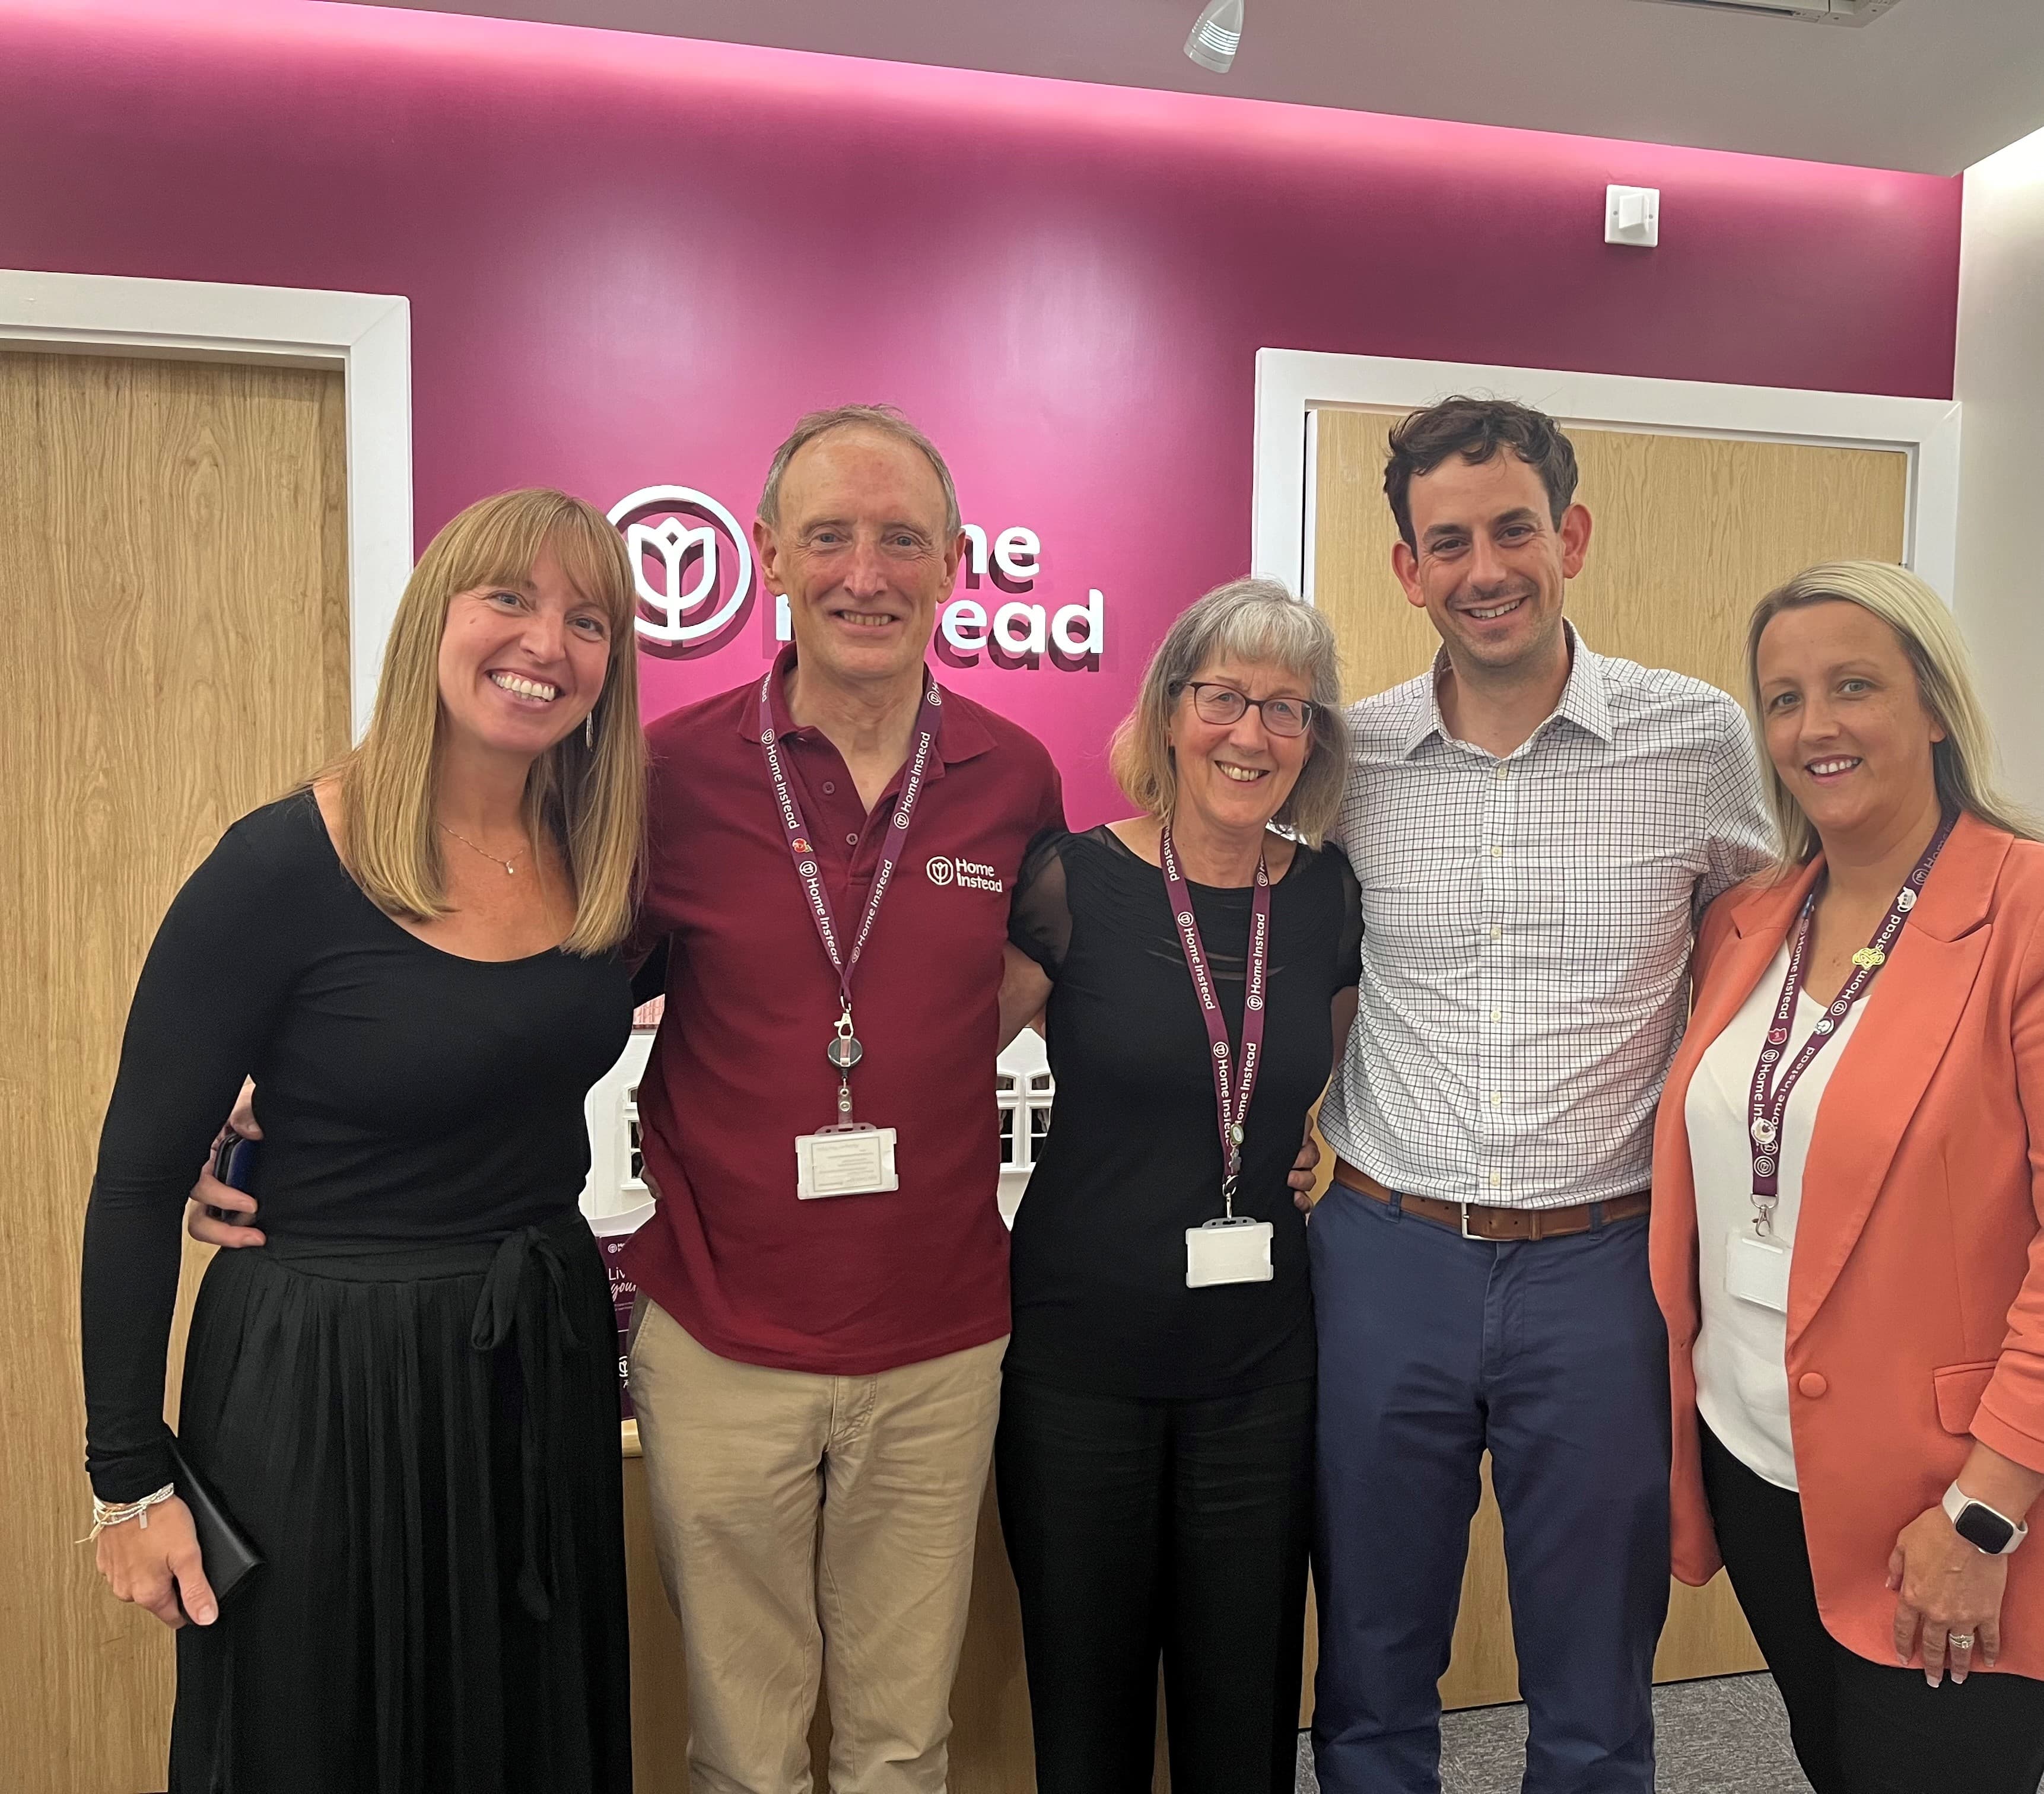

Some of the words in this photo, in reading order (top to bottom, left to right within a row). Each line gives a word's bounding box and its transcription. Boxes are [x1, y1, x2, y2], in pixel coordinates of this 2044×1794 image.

[766, 743, 783, 783] Home
[776, 781, 800, 829] Instead
[900, 776, 920, 813] Home
[910, 731, 931, 776] Instead
[955, 857, 995, 877] Home
[956, 872, 1003, 892] Instead
[1164, 837, 1180, 882] Instead
[806, 877, 826, 916] Home
[819, 917, 841, 965] Instead
[857, 908, 876, 947] Home
[870, 859, 893, 908] Instead
[1253, 913, 1266, 958] Instead
[1790, 936, 1805, 973] Home
[1842, 969, 1868, 1000] Hom
[1875, 914, 1902, 950] stead
[1184, 927, 1200, 964] Home
[1194, 964, 1216, 1010] Instead
[1250, 958, 1263, 994] Home
[1778, 974, 1798, 1020] Instead
[1218, 1058, 1229, 1098] Home
[1240, 1042, 1257, 1091] Instead
[1754, 1064, 1772, 1101] Home
[1770, 1093, 1785, 1130] ome
[1779, 1046, 1816, 1093] Instead
